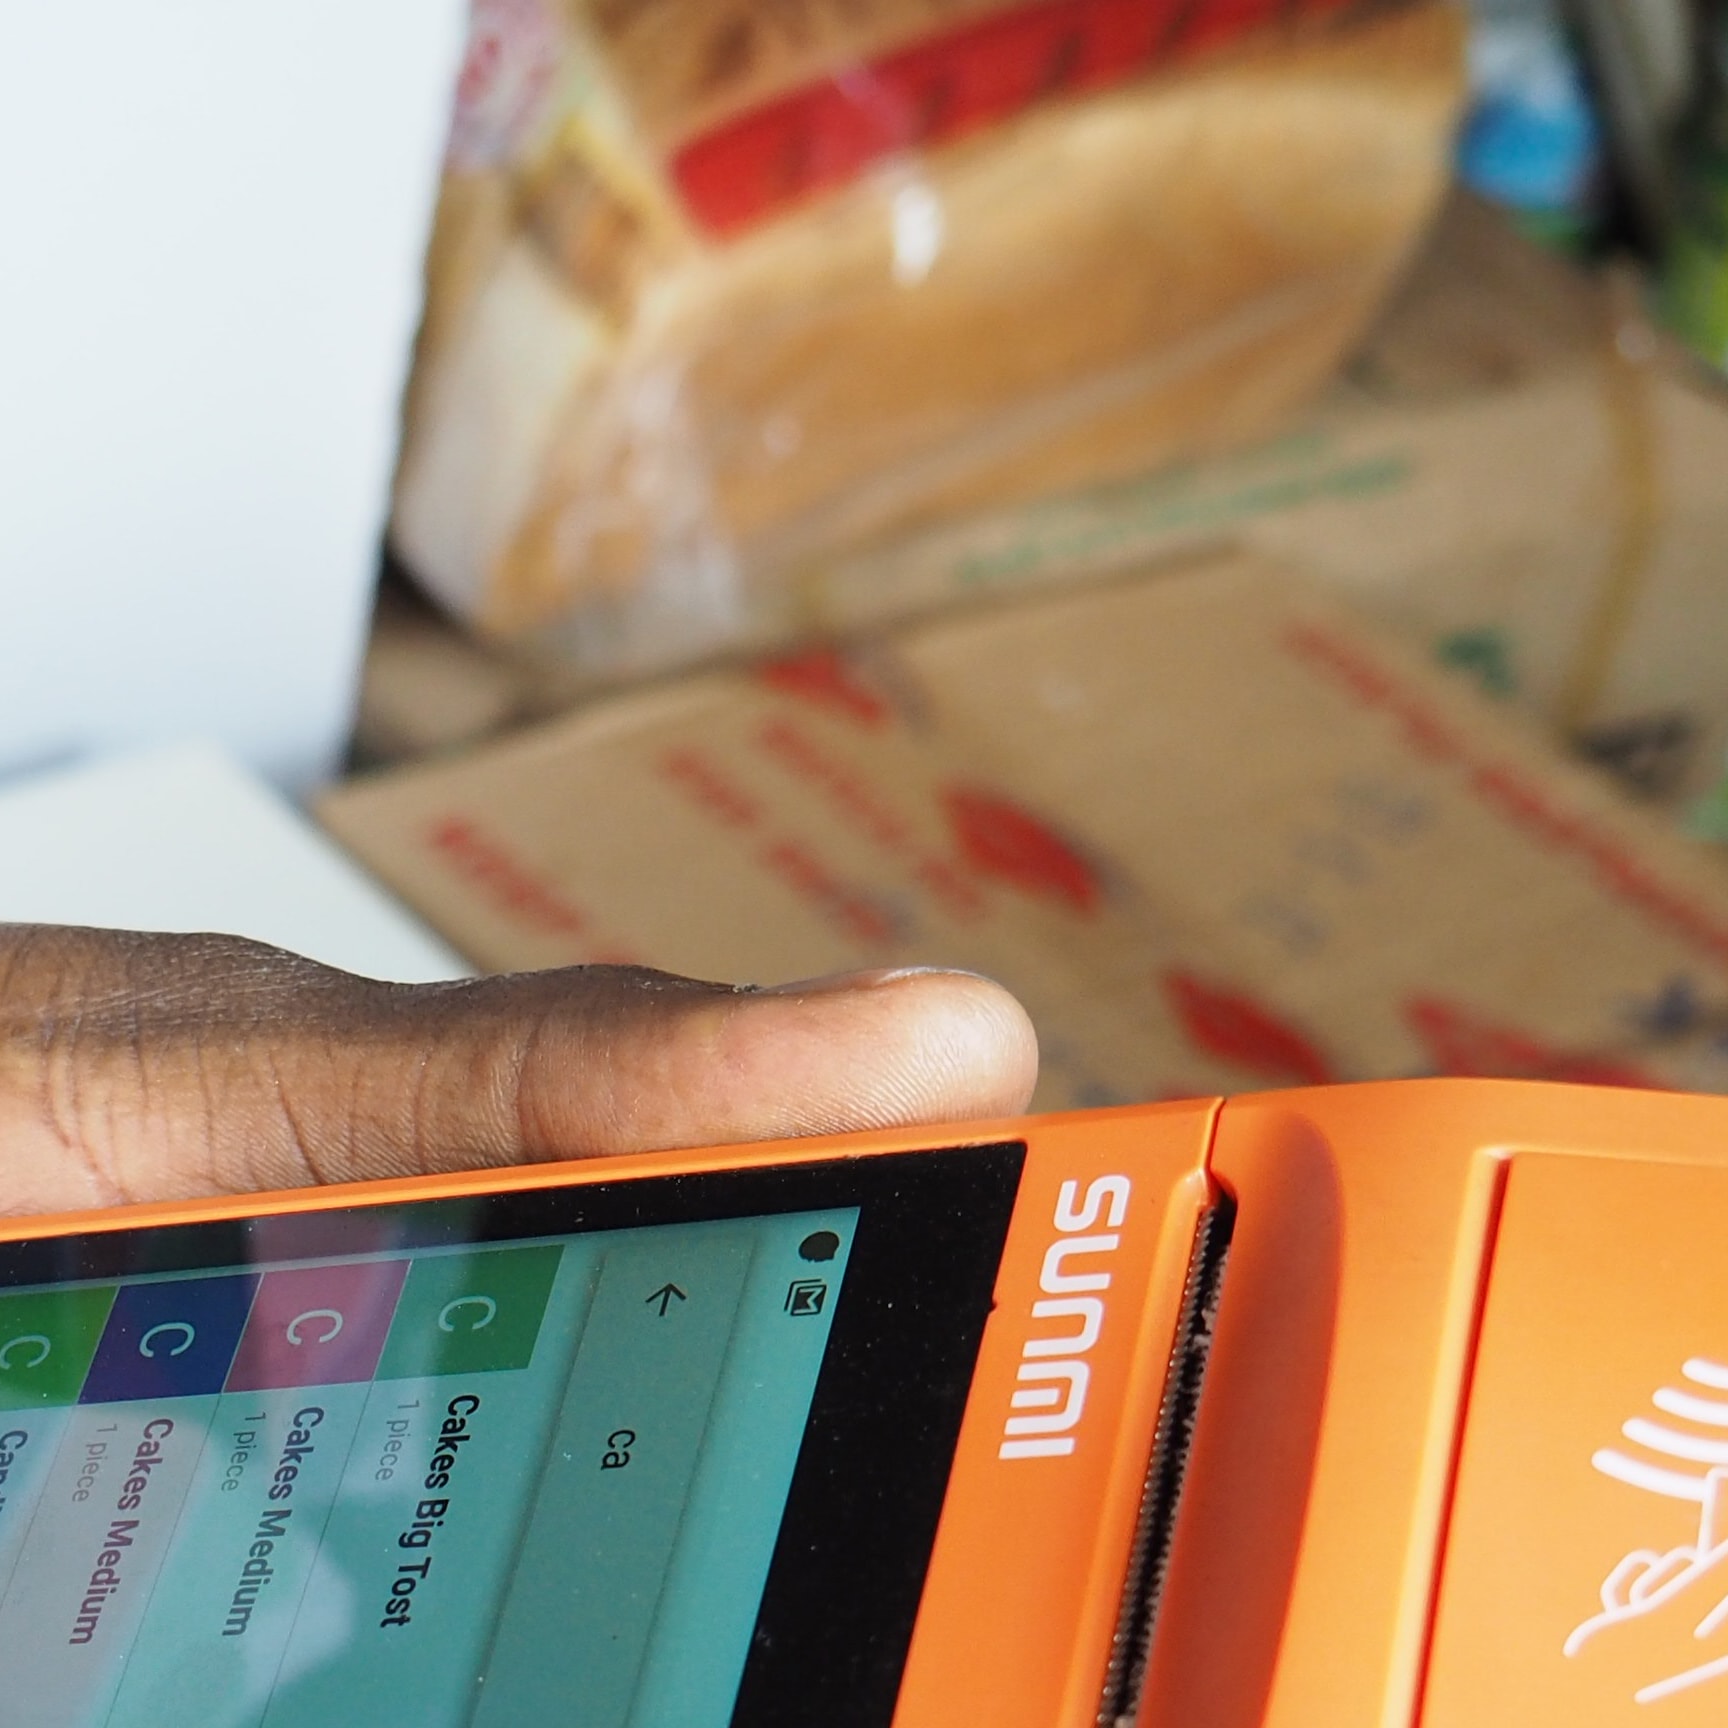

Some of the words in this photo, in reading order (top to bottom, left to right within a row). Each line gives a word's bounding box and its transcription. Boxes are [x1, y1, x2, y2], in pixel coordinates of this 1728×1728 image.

[138, 1321, 197, 1359] C
[285, 1308, 344, 1348] C
[437, 1294, 497, 1333] C
[997, 1172, 1132, 1462] SUNMI
[72, 1442, 108, 1503] piece
[117, 1418, 175, 1511] Cakes
[220, 1429, 257, 1493] piece
[268, 1405, 325, 1500] Cakes
[374, 1414, 412, 1483] piece
[426, 1393, 480, 1502] Cakes
[599, 1427, 637, 1471] ca
[398, 1496, 451, 1552] Big
[69, 1519, 140, 1646] Medium
[221, 1508, 293, 1638] Medium
[379, 1554, 434, 1630] Tost
